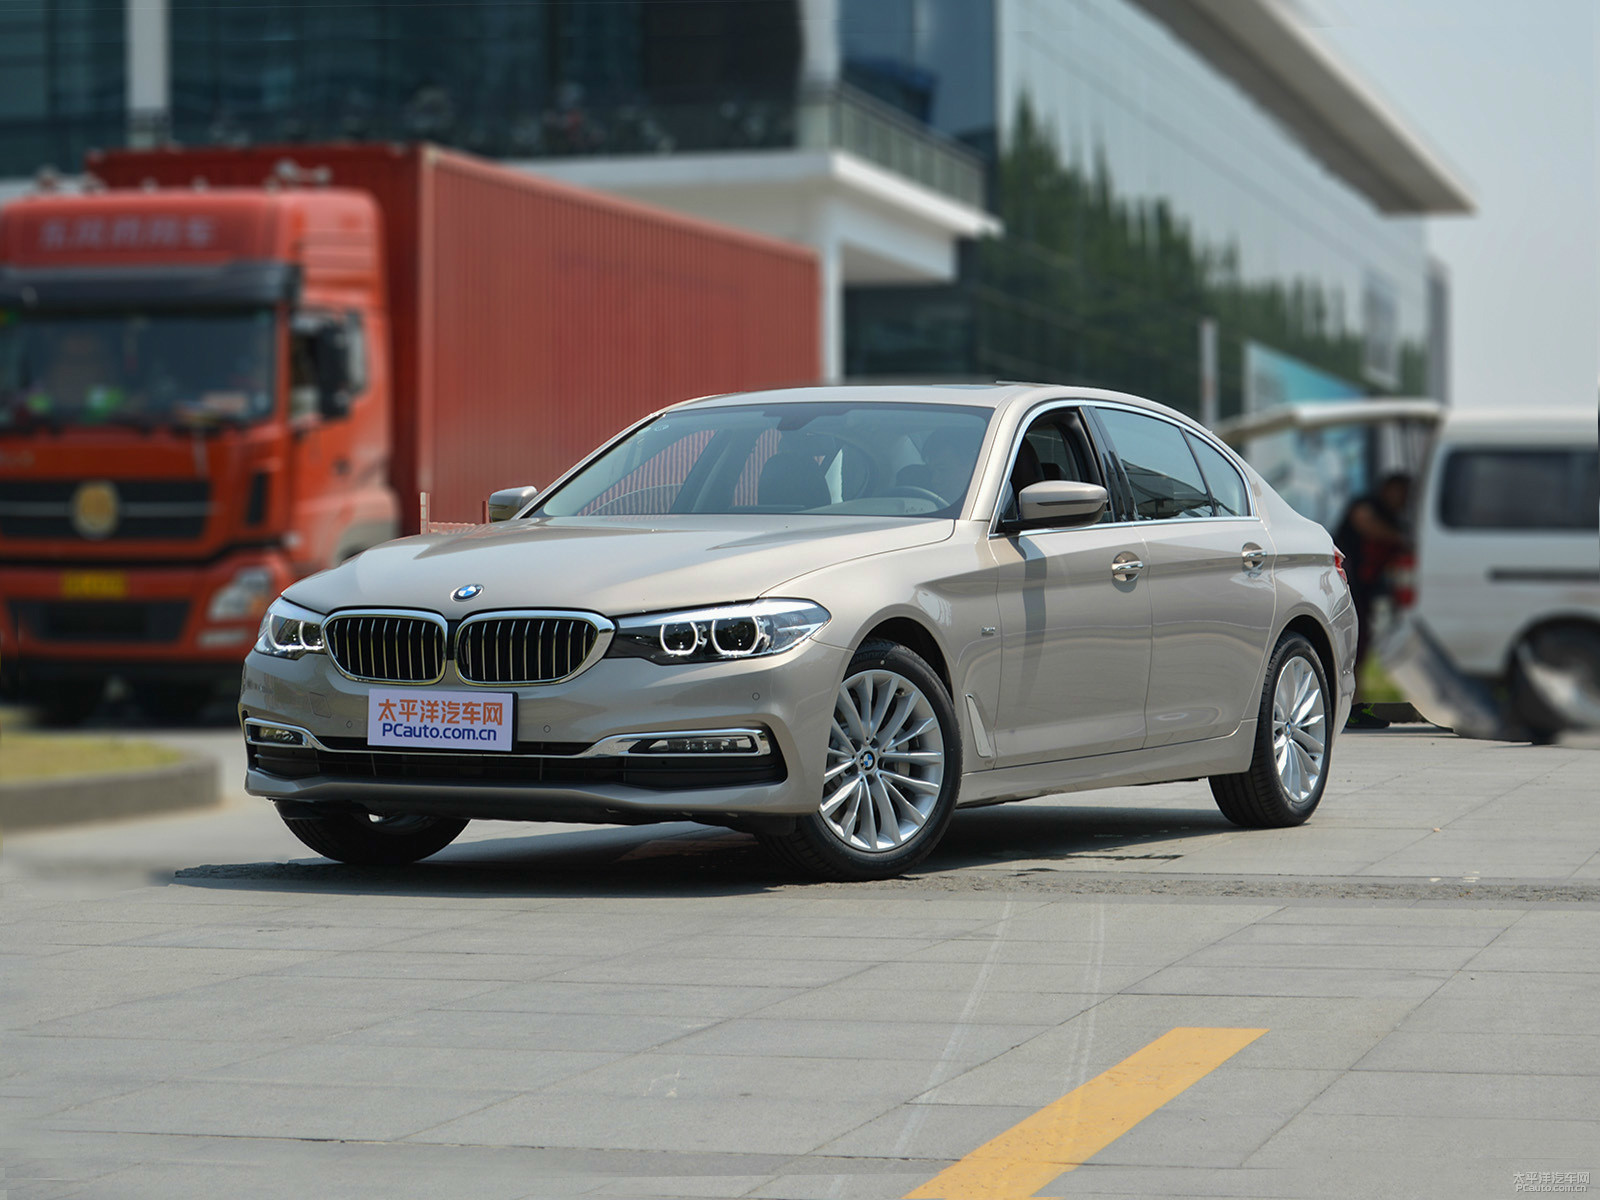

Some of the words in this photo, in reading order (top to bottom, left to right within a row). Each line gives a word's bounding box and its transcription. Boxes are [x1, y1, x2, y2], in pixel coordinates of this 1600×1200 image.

[378, 698, 503, 726] 太平洋汽车网
[382, 722, 497, 741] PCauto.com.cn
